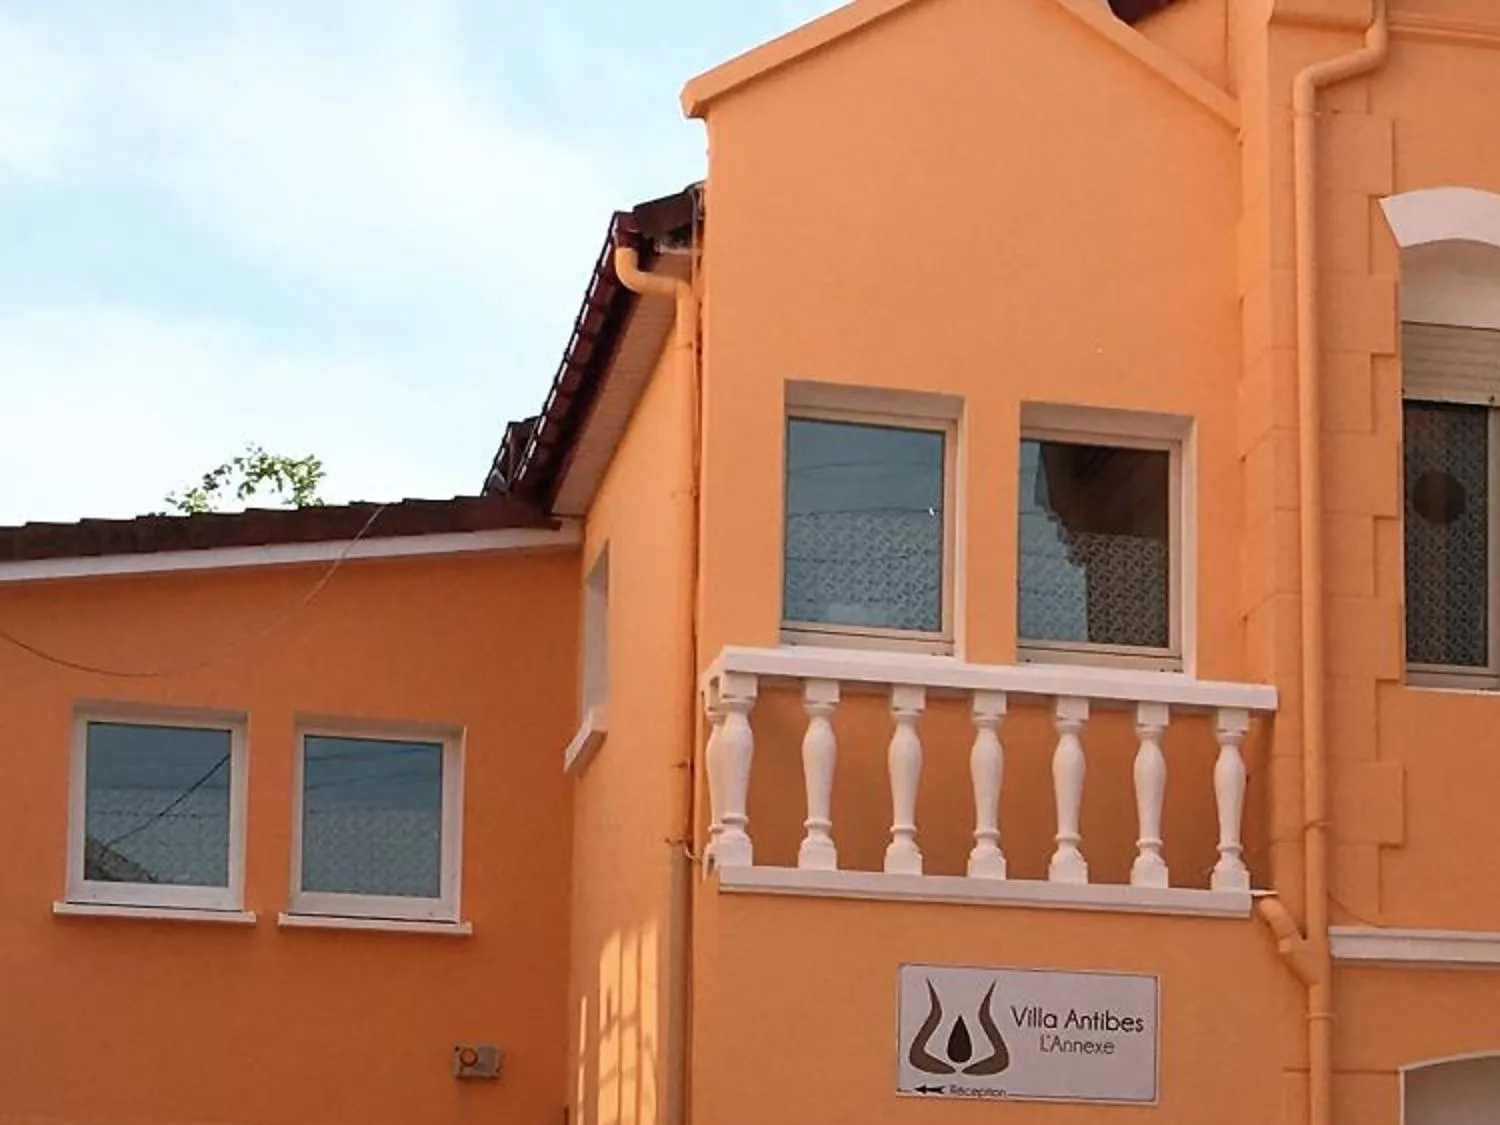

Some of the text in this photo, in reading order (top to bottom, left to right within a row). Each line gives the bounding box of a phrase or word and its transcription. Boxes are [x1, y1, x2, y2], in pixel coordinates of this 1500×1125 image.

[1010, 1005, 1145, 1033] Villa Antibes
[1039, 1034, 1116, 1055] L'Annexe
